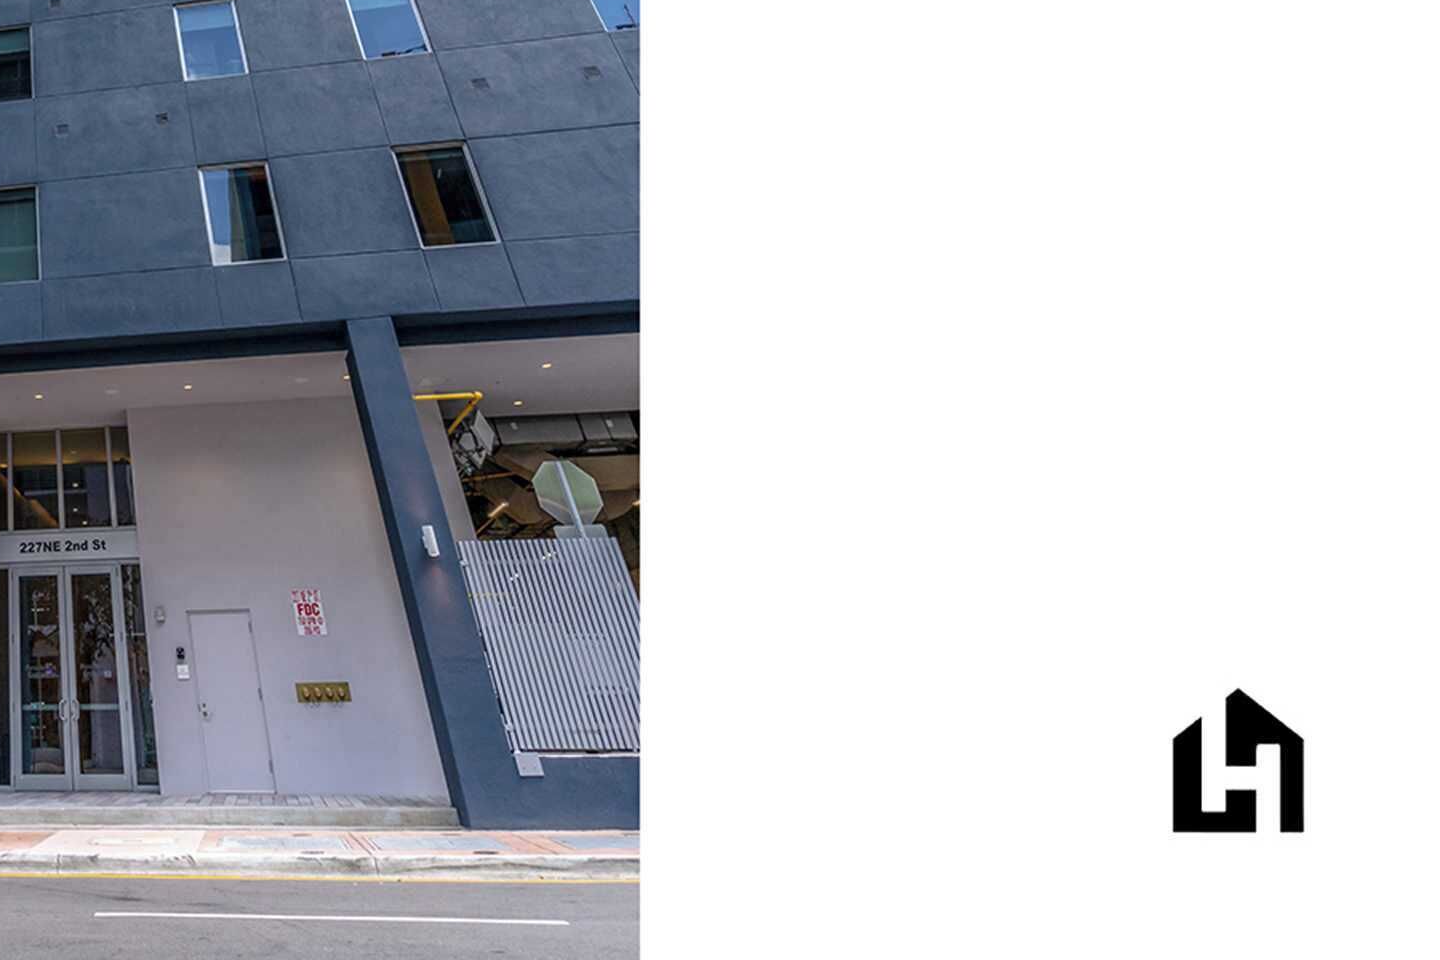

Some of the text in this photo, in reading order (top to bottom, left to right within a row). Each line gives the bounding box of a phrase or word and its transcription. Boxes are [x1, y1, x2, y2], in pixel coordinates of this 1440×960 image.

[20, 539, 106, 553] 227NE 2nd St
[296, 602, 320, 616] FDC
